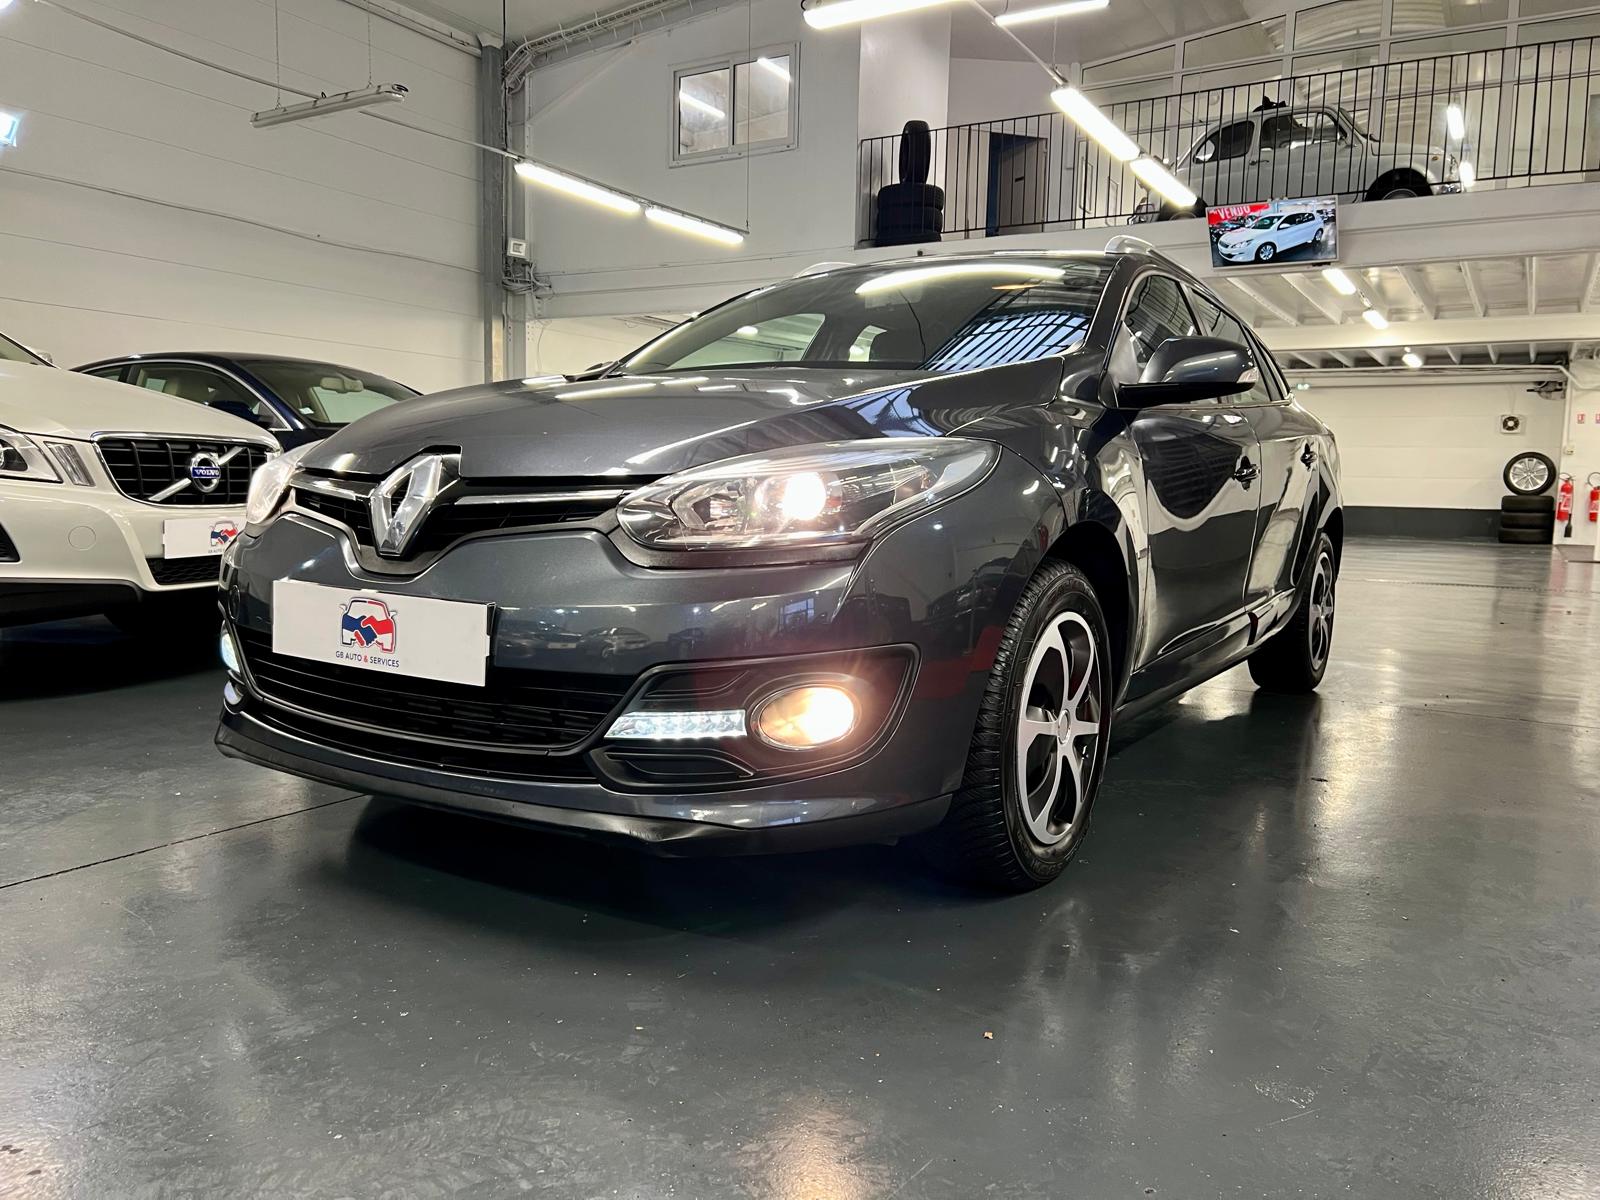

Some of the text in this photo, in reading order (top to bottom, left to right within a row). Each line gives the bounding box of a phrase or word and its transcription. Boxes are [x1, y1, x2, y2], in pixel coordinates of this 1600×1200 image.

[336, 650, 400, 668] GB AUTO & SERVICES
